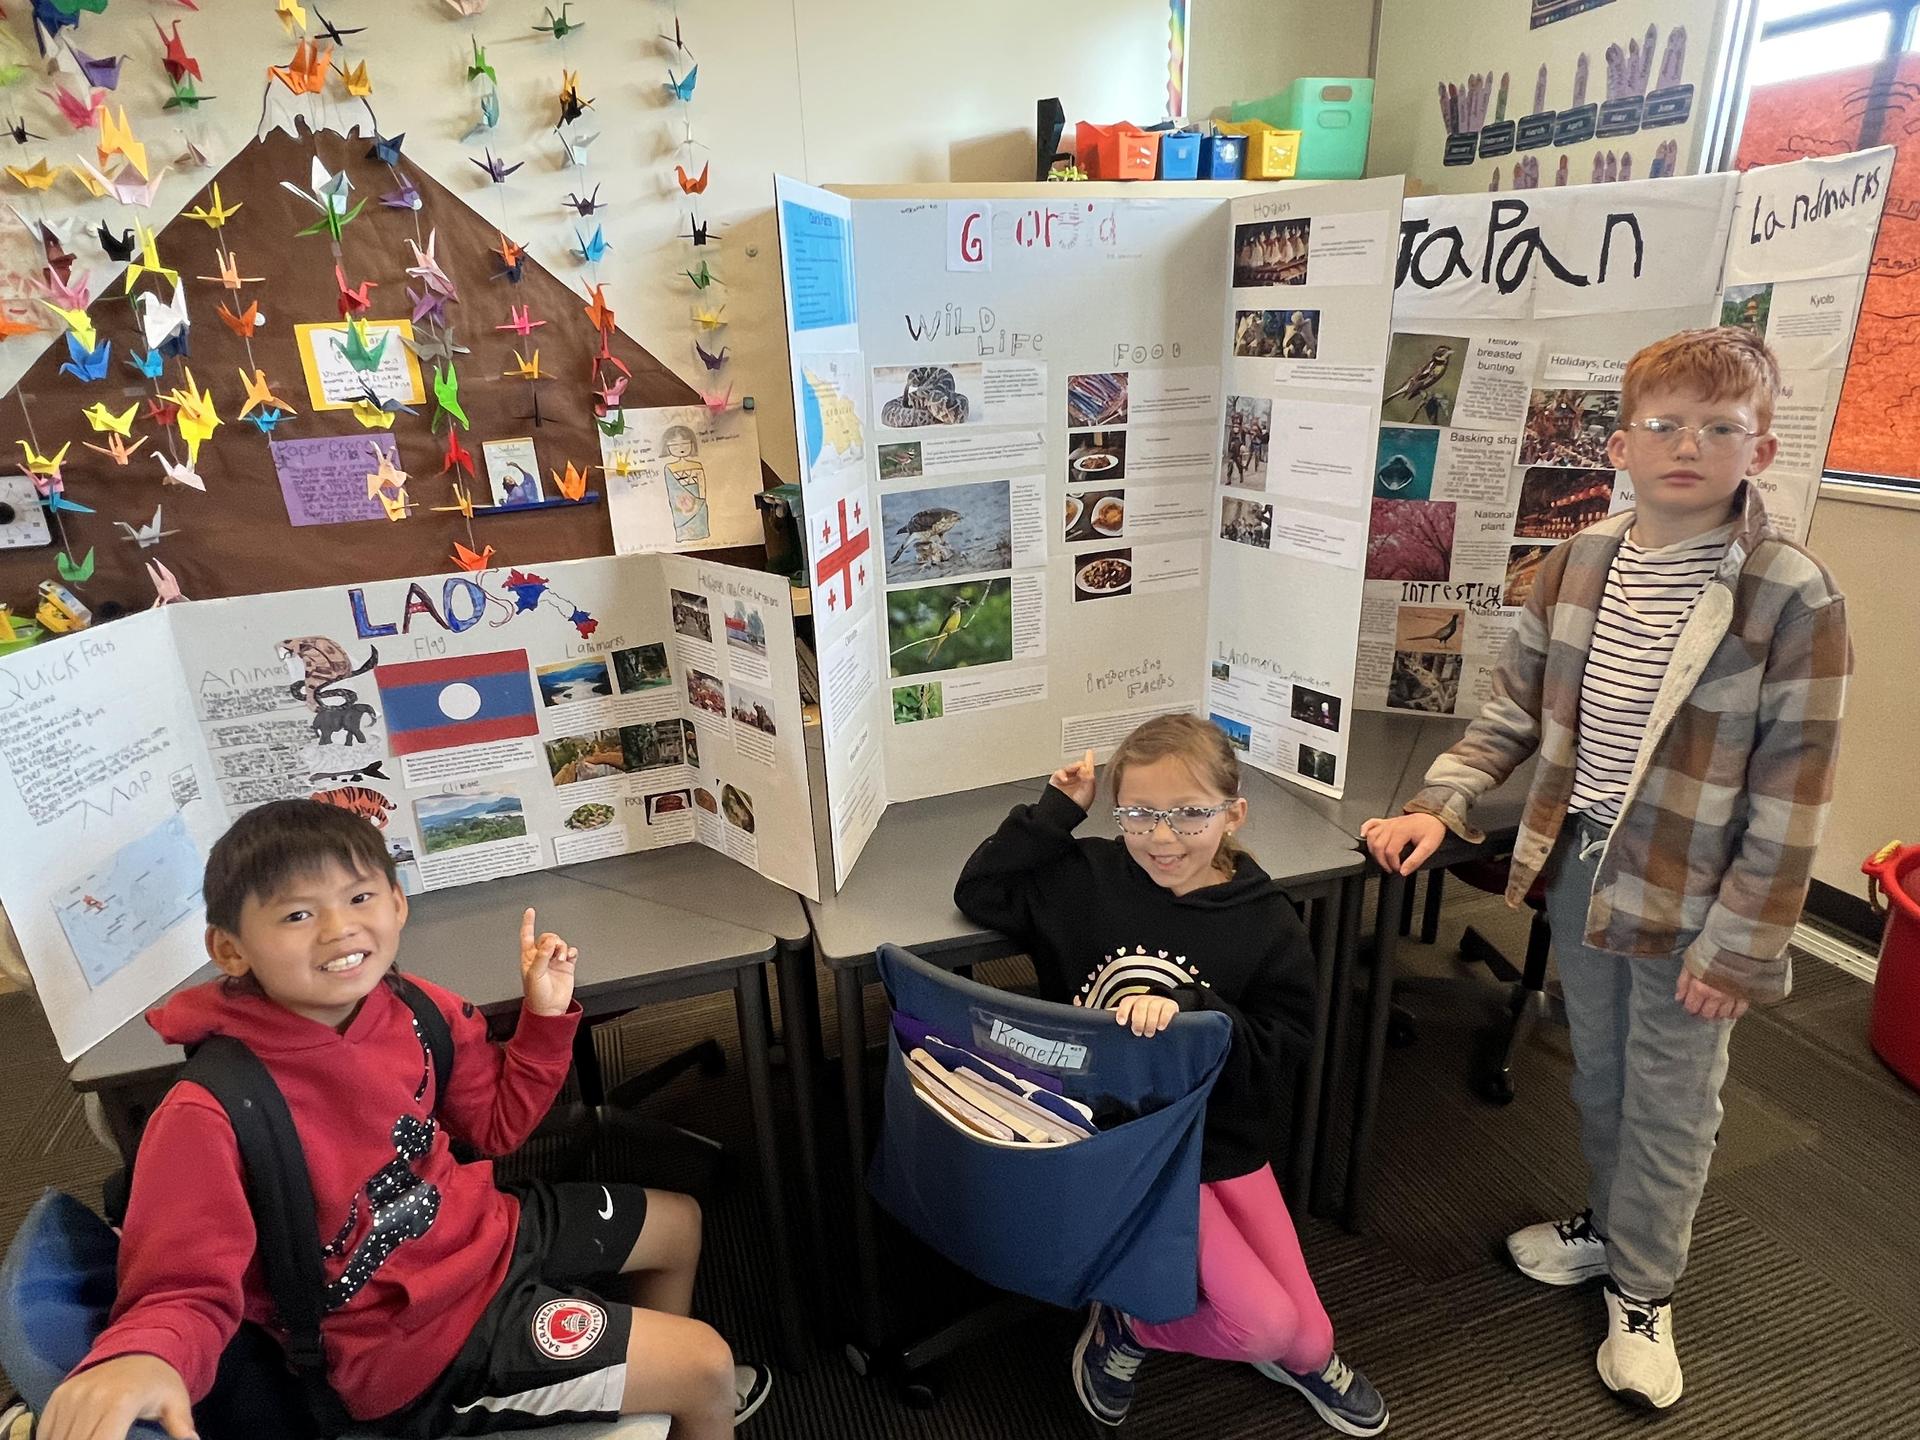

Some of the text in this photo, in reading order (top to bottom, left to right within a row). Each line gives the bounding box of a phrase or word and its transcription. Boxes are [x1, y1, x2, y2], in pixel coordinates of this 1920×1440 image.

[1810, 294, 1835, 307] Kyoto
[1477, 348, 1522, 360] breasted
[1478, 360, 1515, 375] bunting
[1550, 355, 1600, 369] Holidays,
[1450, 432, 1494, 445] Basking
[1756, 479, 1777, 492] Tokyo
[1474, 510, 1514, 520] National
[1481, 522, 1505, 532] plant
[348, 568, 515, 640] LAOS
[414, 636, 447, 659] Flag
[996, 1022, 1069, 1068] Kenneth
[538, 1303, 566, 1353] SACRAMENTO
[585, 1308, 600, 1341] UNITED
